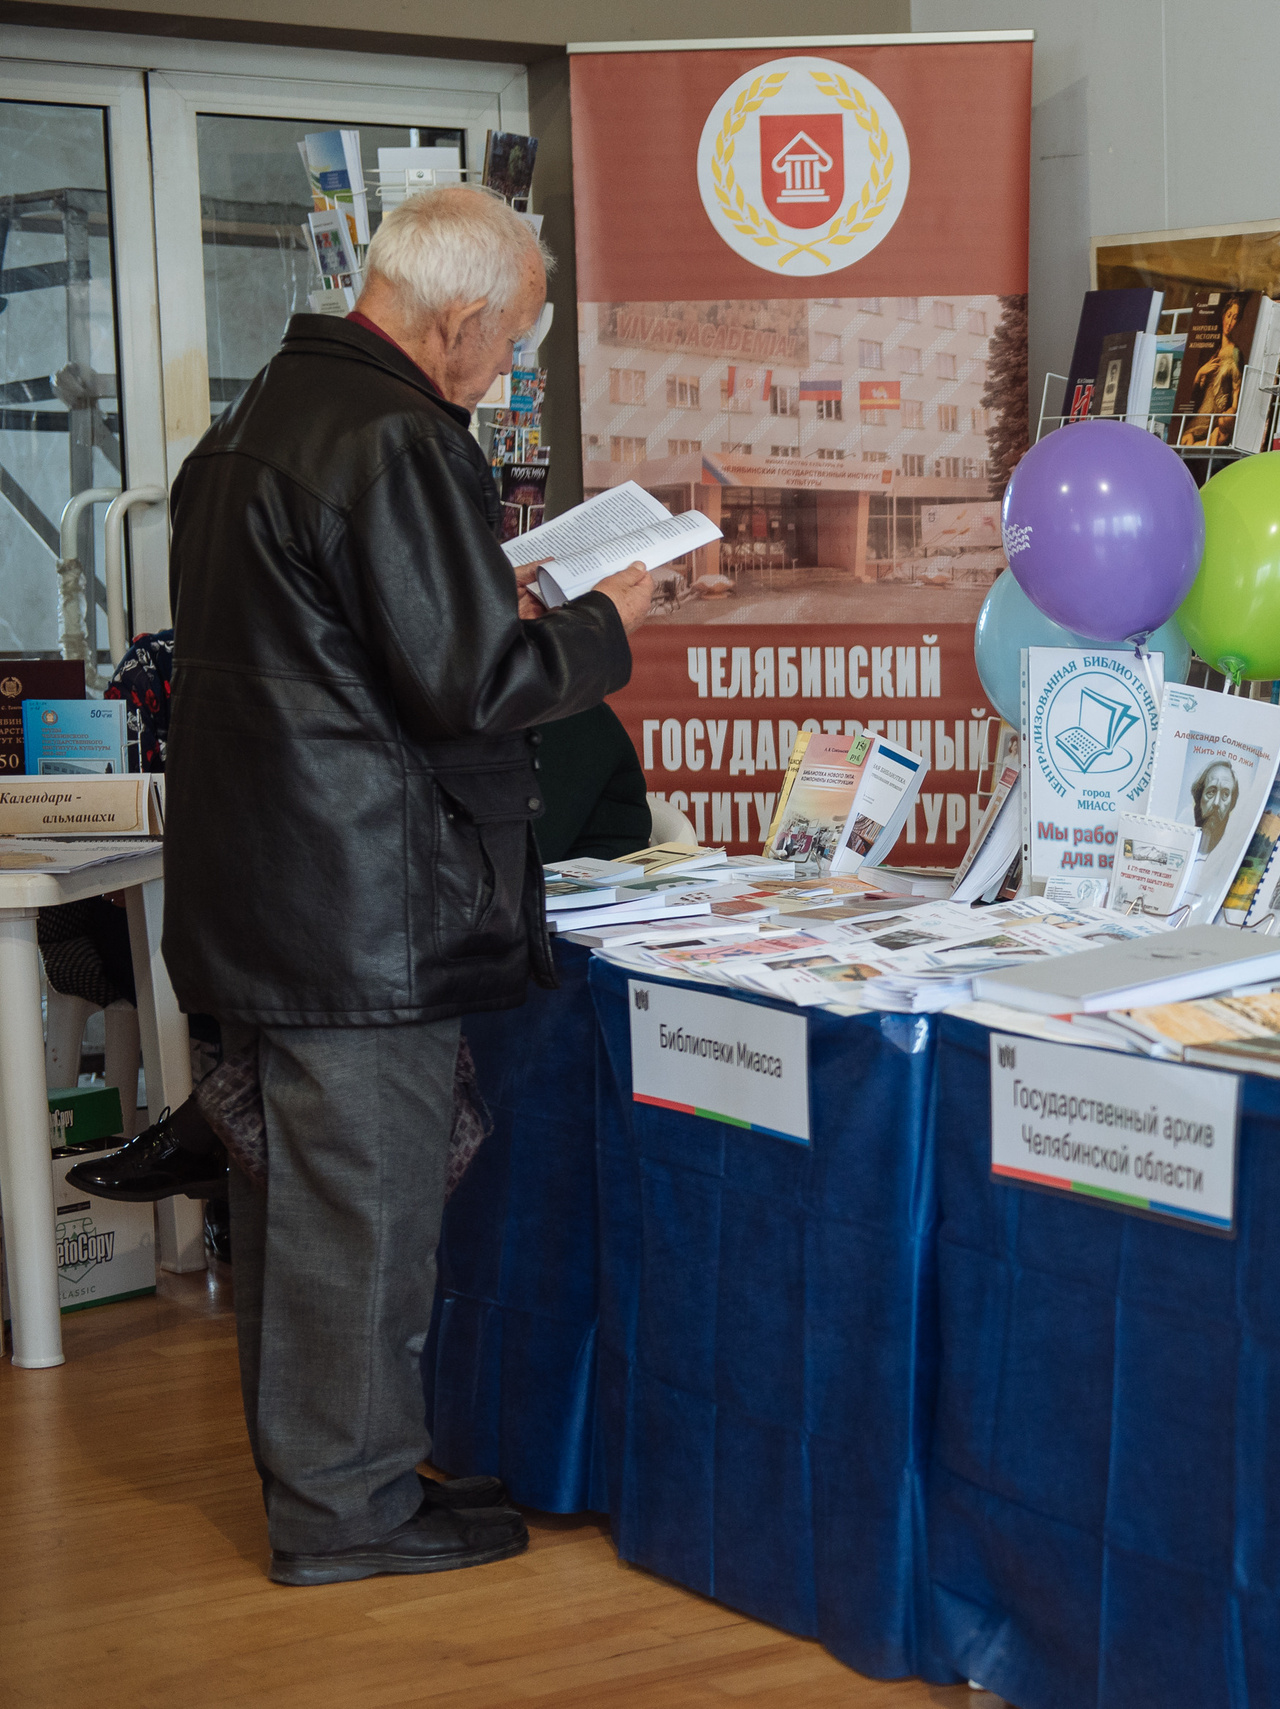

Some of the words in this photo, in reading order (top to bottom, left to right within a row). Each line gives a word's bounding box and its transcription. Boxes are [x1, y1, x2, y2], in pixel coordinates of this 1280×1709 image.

[777, 468, 846, 479] ГОСУДАРСТВЕННЫЙ
[687, 634, 941, 698] ЧЕЛЯБИНСКИЙ
[90, 709, 102, 718] 50
[1174, 729, 1220, 743] Александр
[1221, 734, 1271, 761] Солженицын.
[1193, 745, 1215, 756] Жить
[1216, 750, 1226, 758] не
[1228, 753, 1238, 763] по
[1239, 756, 1254, 768] лжи
[803, 769, 827, 778] БИБЛИОТЕКА
[828, 772, 844, 780] НОВОГО
[827, 778, 854, 787] КОНСТРУКЦИИ
[0, 792, 73, 805] Календари
[1082, 789, 1111, 800] город
[1077, 800, 1116, 812] МИАСС
[43, 813, 115, 824] альманахи
[1037, 821, 1068, 841] Мы
[1061, 852, 1095, 869] для
[659, 1023, 734, 1065] Библиотеки
[736, 1041, 783, 1079] Миасса
[1013, 1079, 1158, 1136] Государственный
[1162, 1112, 1215, 1149] архив
[1021, 1123, 1130, 1177] Челябинской
[1134, 1150, 1204, 1193] области
[57, 1231, 115, 1268] etoCopy
